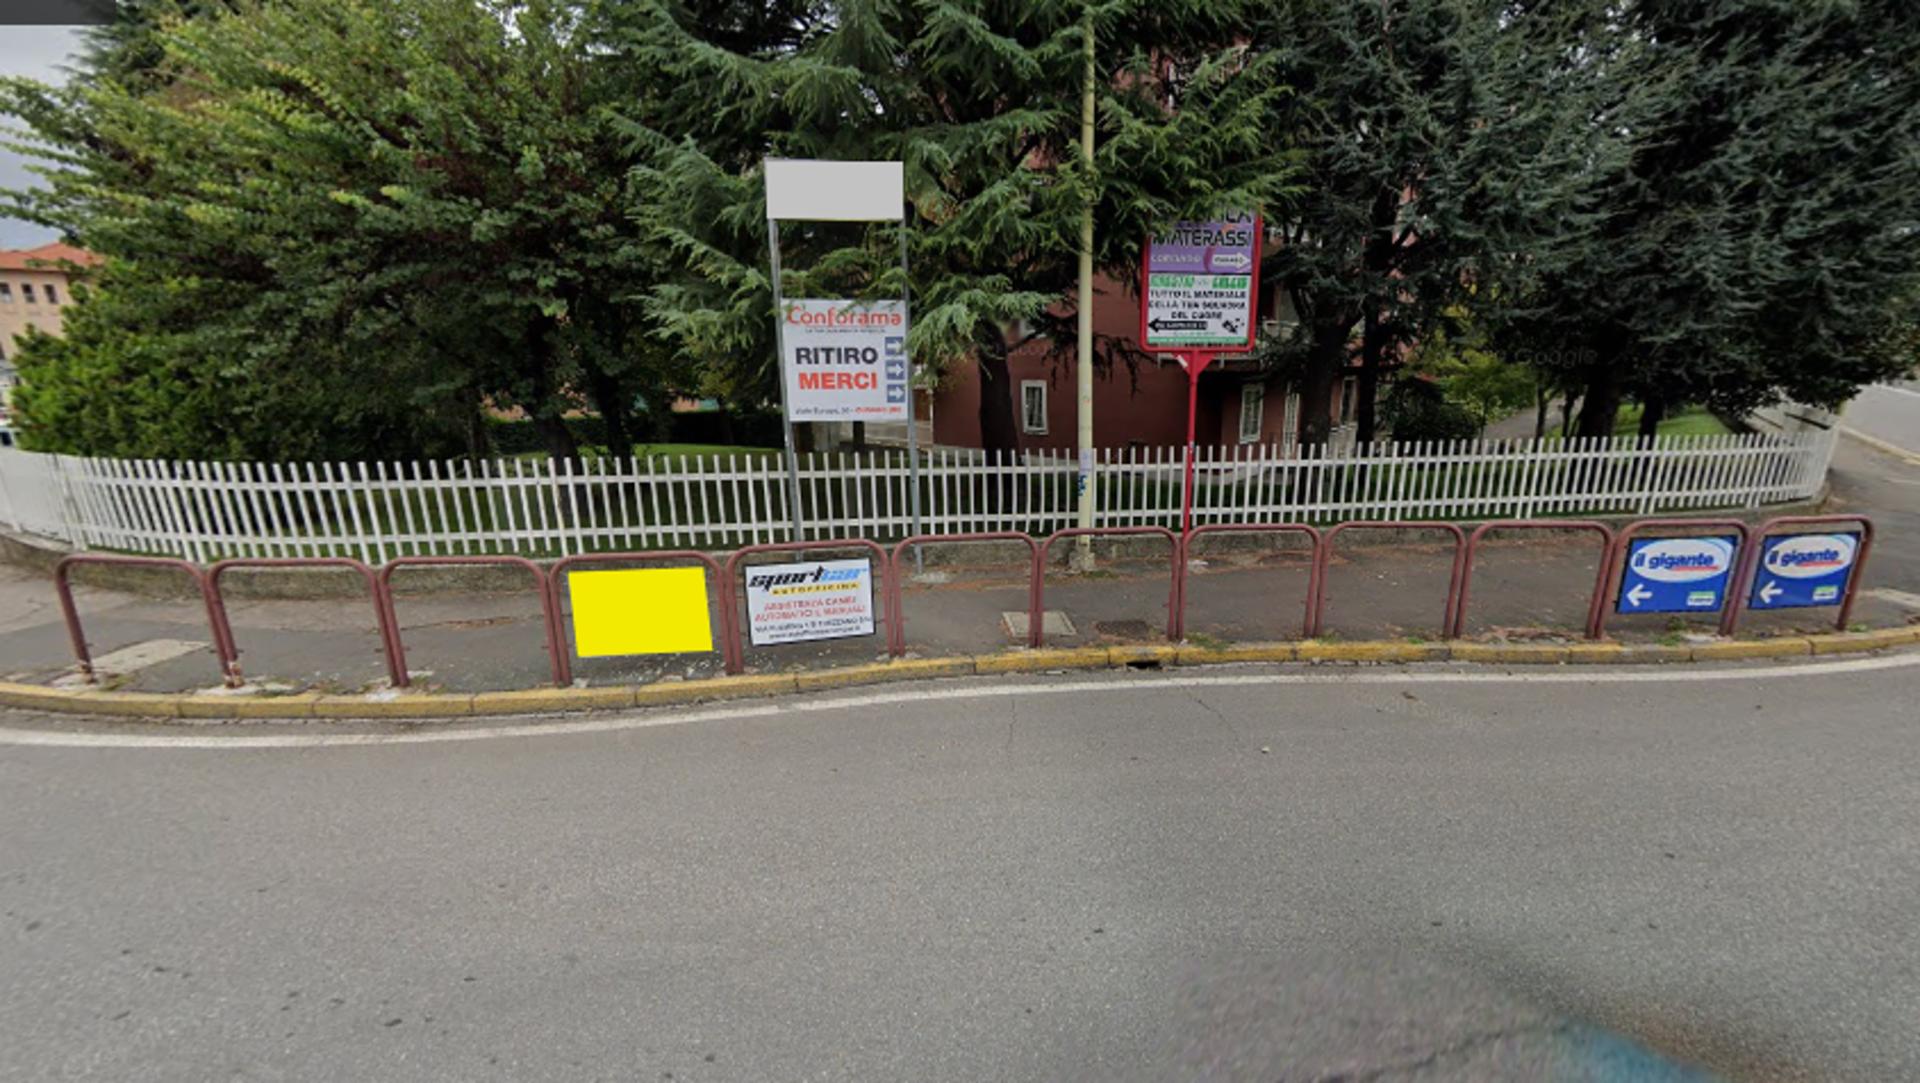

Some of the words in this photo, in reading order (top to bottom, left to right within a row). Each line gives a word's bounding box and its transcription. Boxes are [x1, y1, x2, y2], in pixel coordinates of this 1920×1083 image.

[787, 306, 902, 327] Conforama
[796, 347, 878, 365] RITIRO
[799, 372, 878, 390] MERCI
[1634, 552, 1646, 567] il
[1649, 552, 1714, 570] gigante
[1781, 548, 1839, 567] gigante
